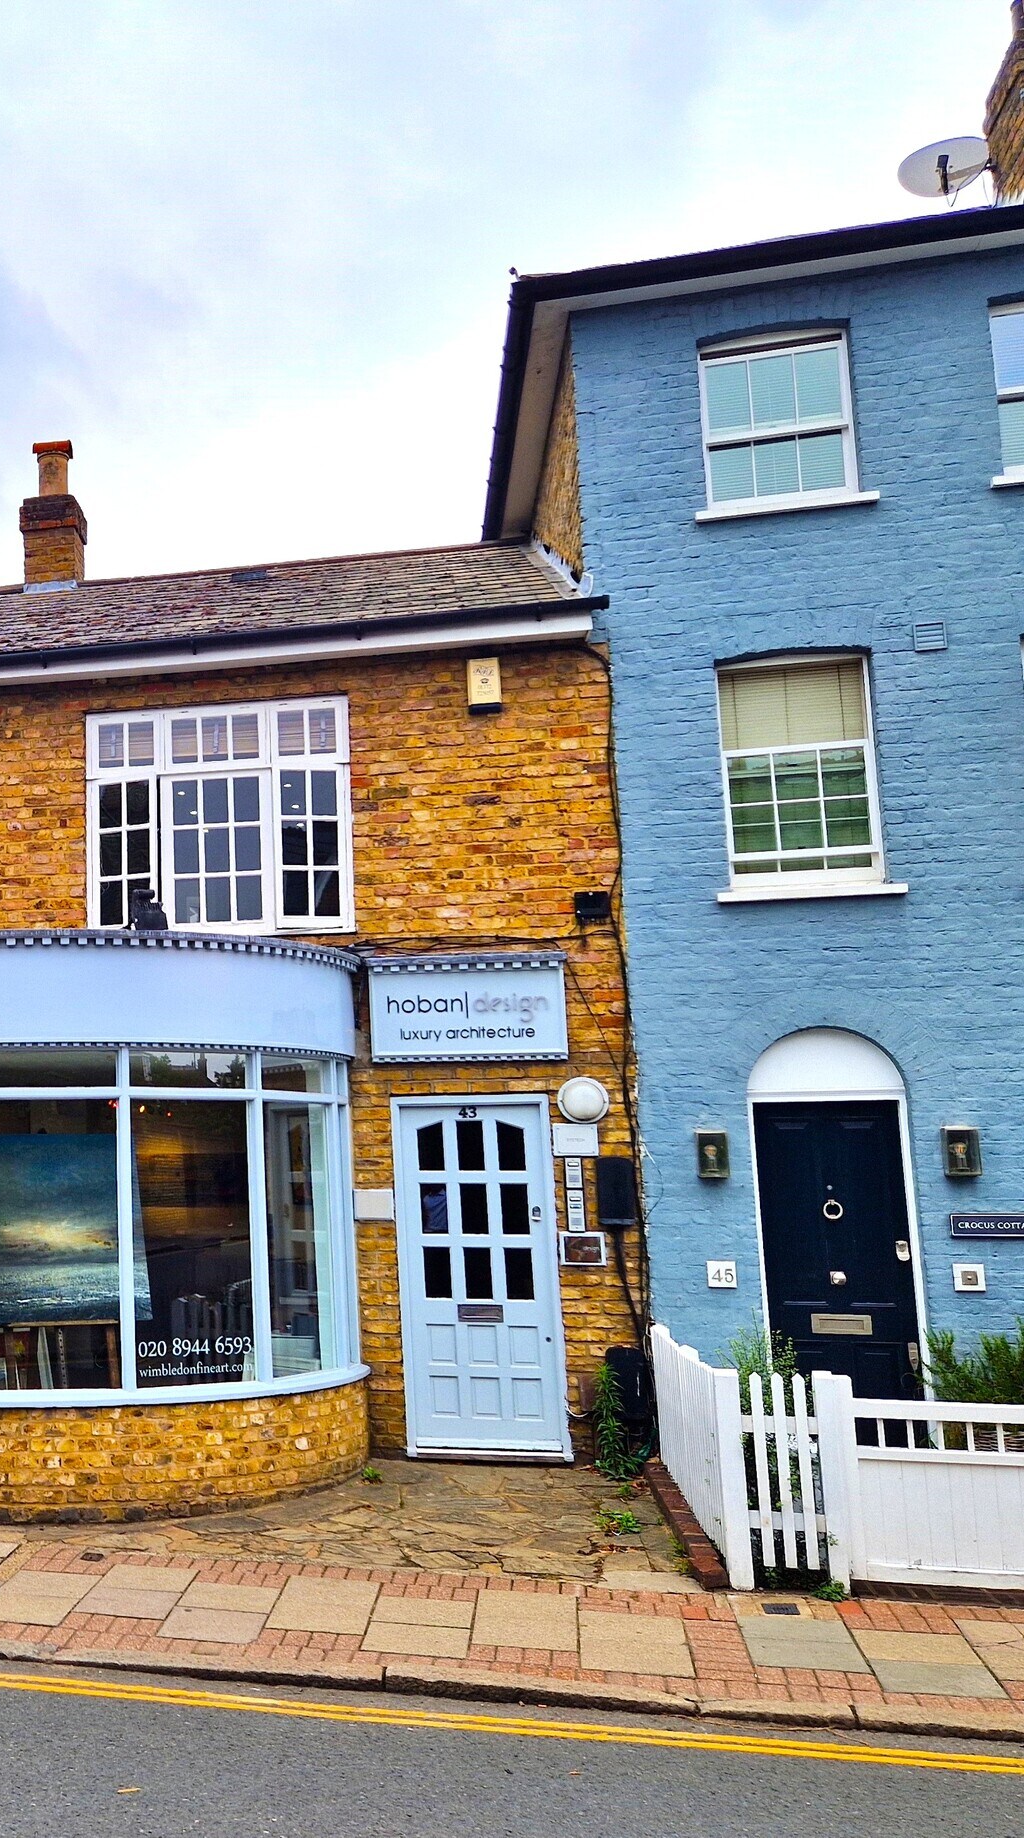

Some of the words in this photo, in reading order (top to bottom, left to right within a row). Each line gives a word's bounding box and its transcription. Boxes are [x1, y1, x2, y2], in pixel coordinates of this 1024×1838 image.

[473, 991, 550, 1023] design
[400, 1027, 442, 1042] luxury
[446, 1025, 536, 1040] architecture
[458, 1106, 477, 1118] 43
[957, 1221, 995, 1229] CROCUS
[711, 1268, 734, 1283] 45
[138, 1340, 167, 1358] 020
[172, 1337, 210, 1357] 8944
[215, 1335, 252, 1355] 6593
[139, 1361, 254, 1377] wimbledonfineart.com
